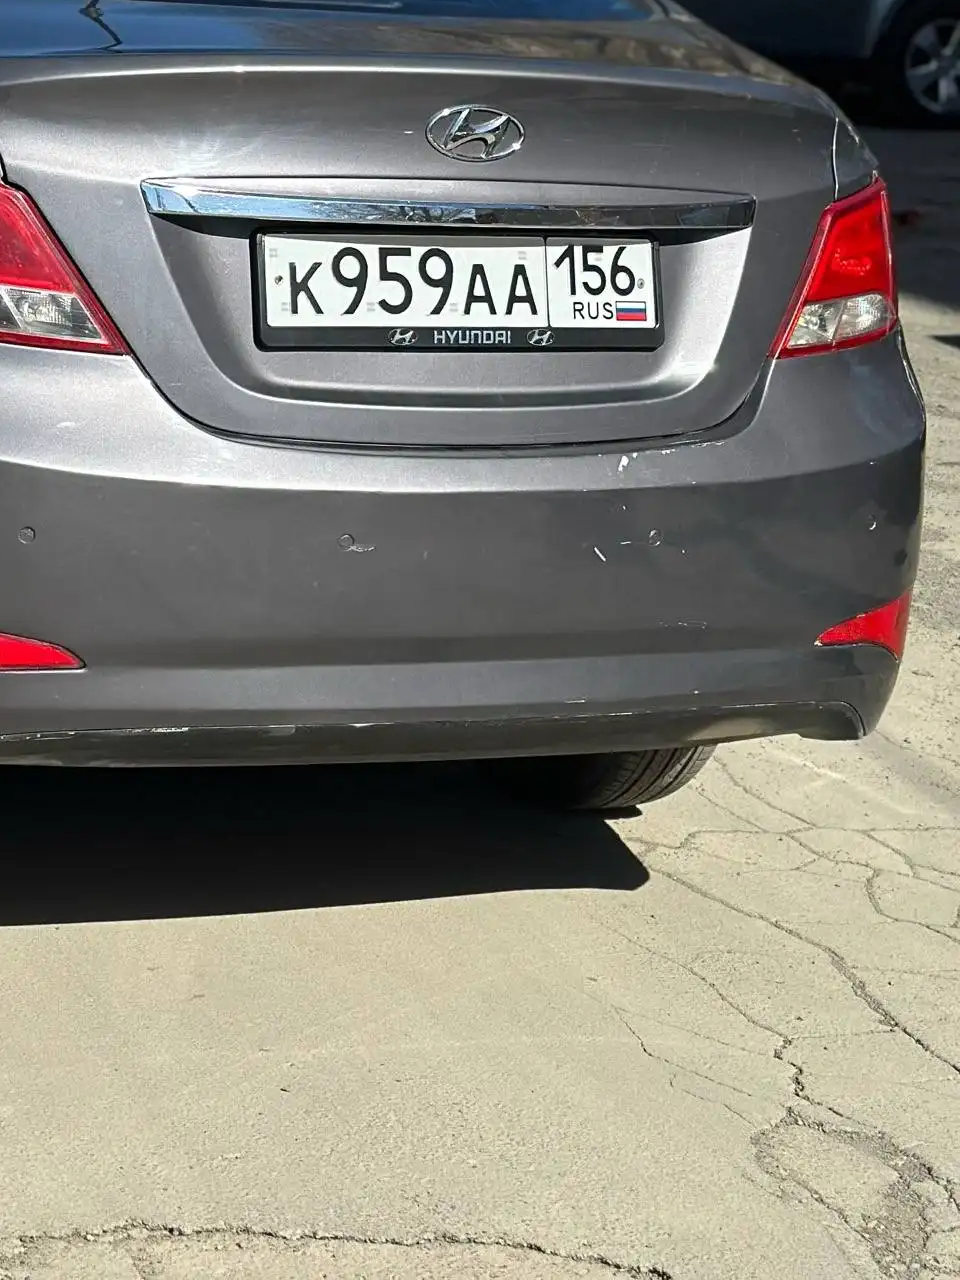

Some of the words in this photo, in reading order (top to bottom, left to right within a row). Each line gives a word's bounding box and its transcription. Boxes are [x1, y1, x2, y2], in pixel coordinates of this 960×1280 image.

[289, 246, 539, 316] К959АА
[553, 244, 636, 297] 156
[572, 301, 614, 320] RUS
[433, 329, 512, 345] HYUNDAI
